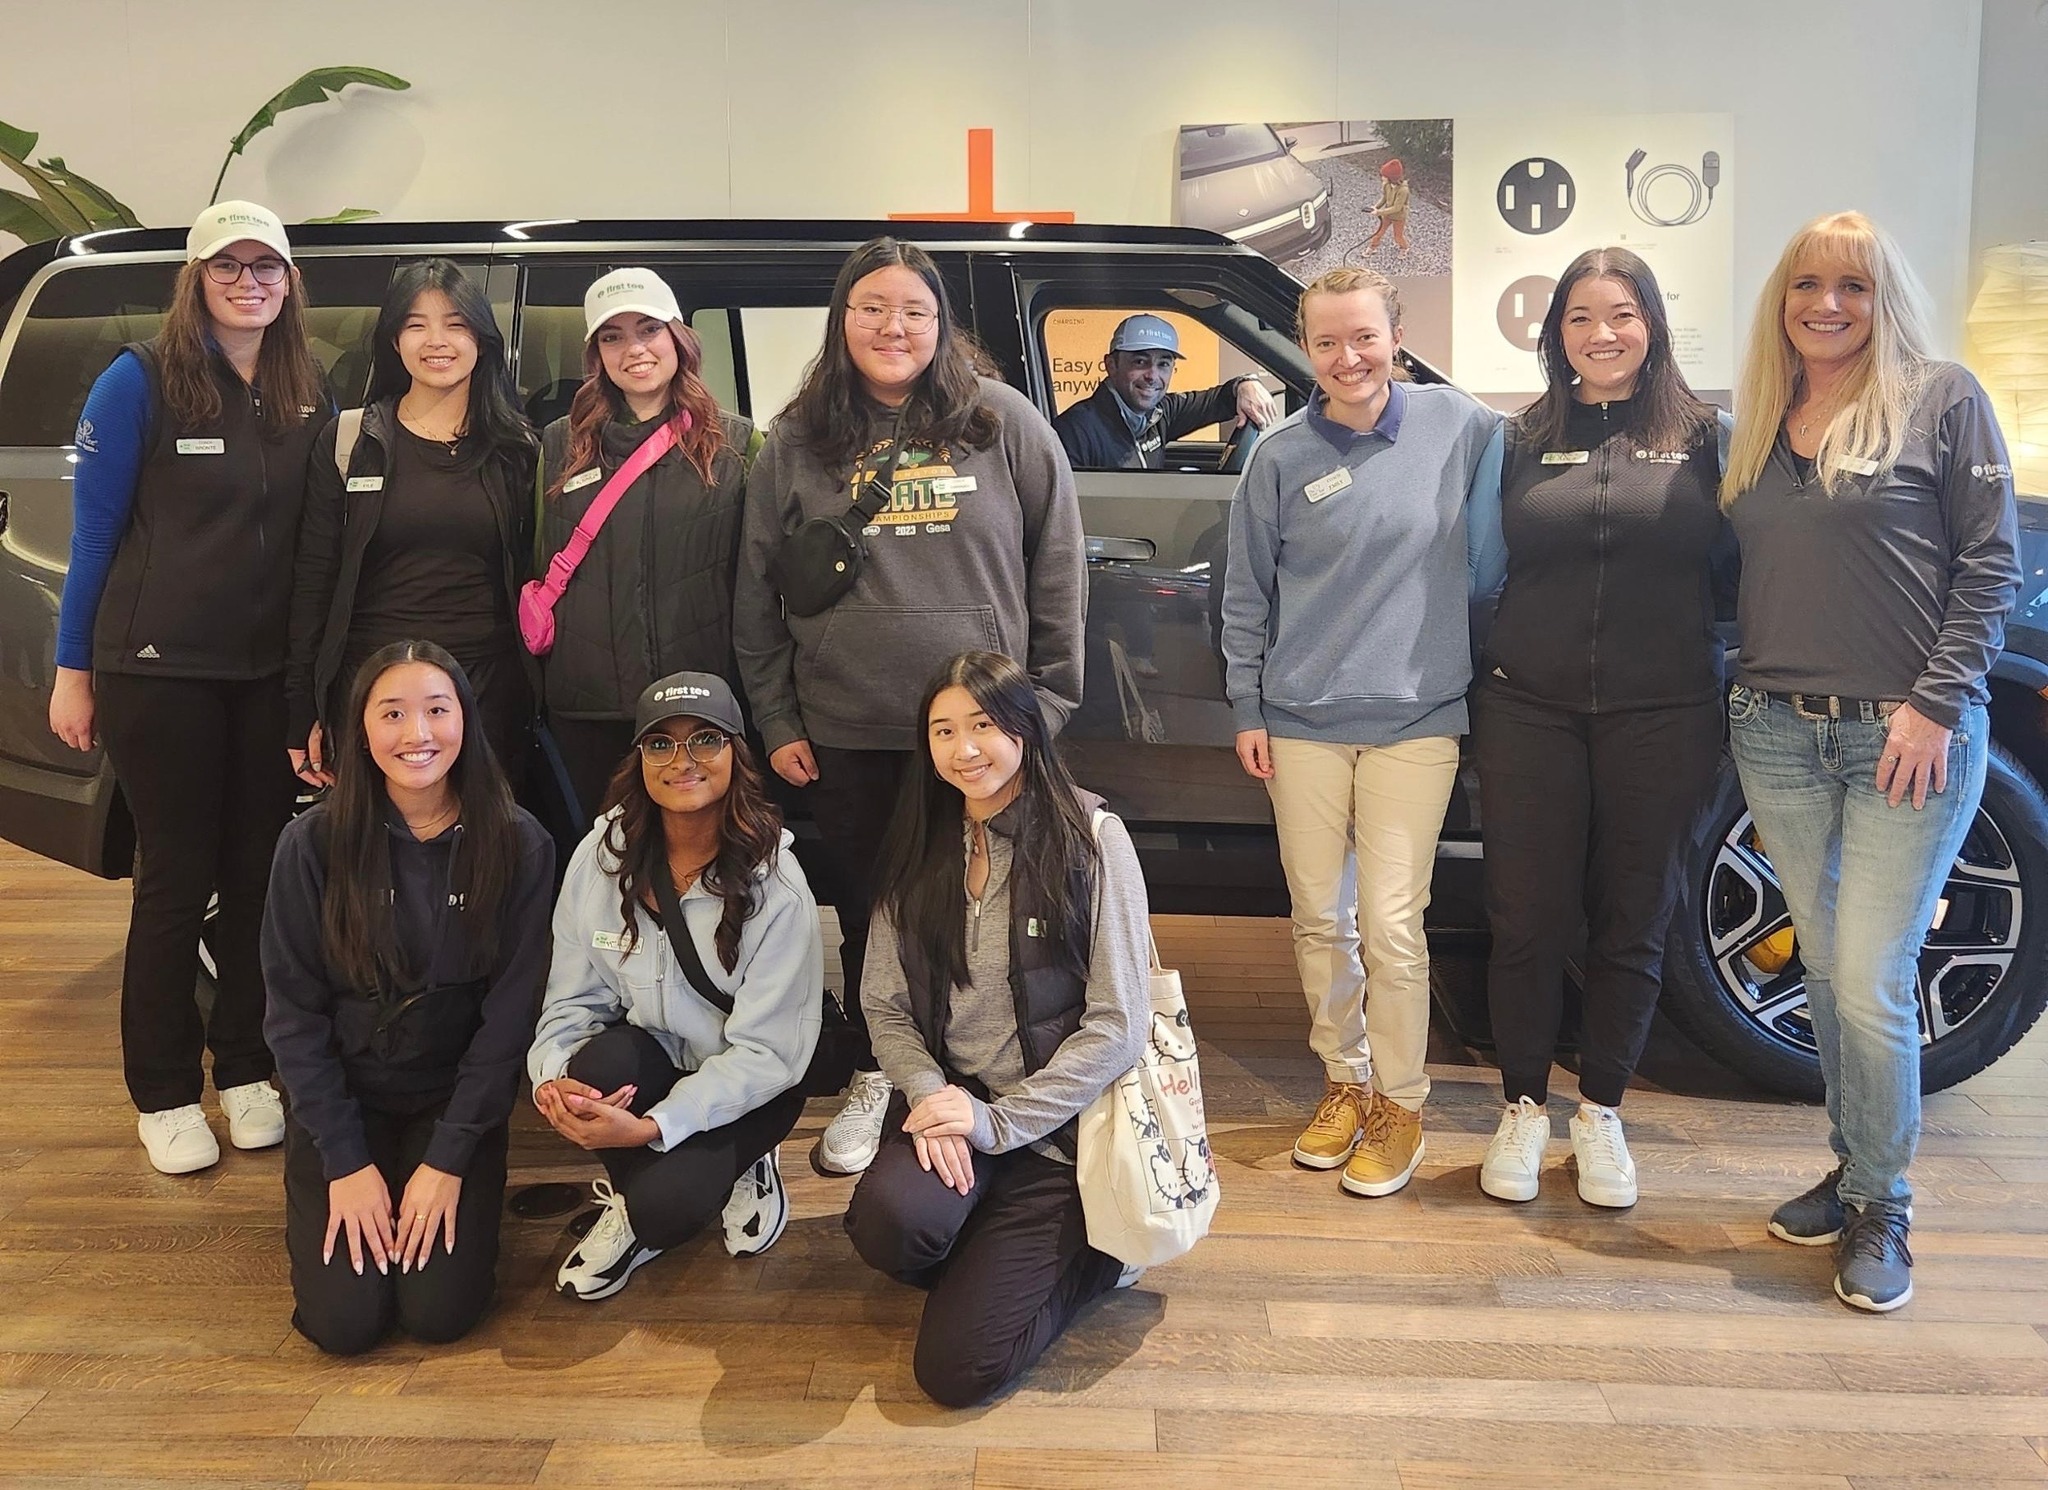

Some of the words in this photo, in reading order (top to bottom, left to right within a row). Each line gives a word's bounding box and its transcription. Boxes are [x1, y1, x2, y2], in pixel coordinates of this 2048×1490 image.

[1666, 291, 1680, 301] for
[1053, 357, 1093, 376] Easy
[1053, 377, 1101, 395] anyw
[876, 511, 950, 523] AMPIONSHIPS
[895, 525, 917, 536] 2023
[665, 686, 689, 697] first
[1157, 1065, 1198, 1098] Hell
